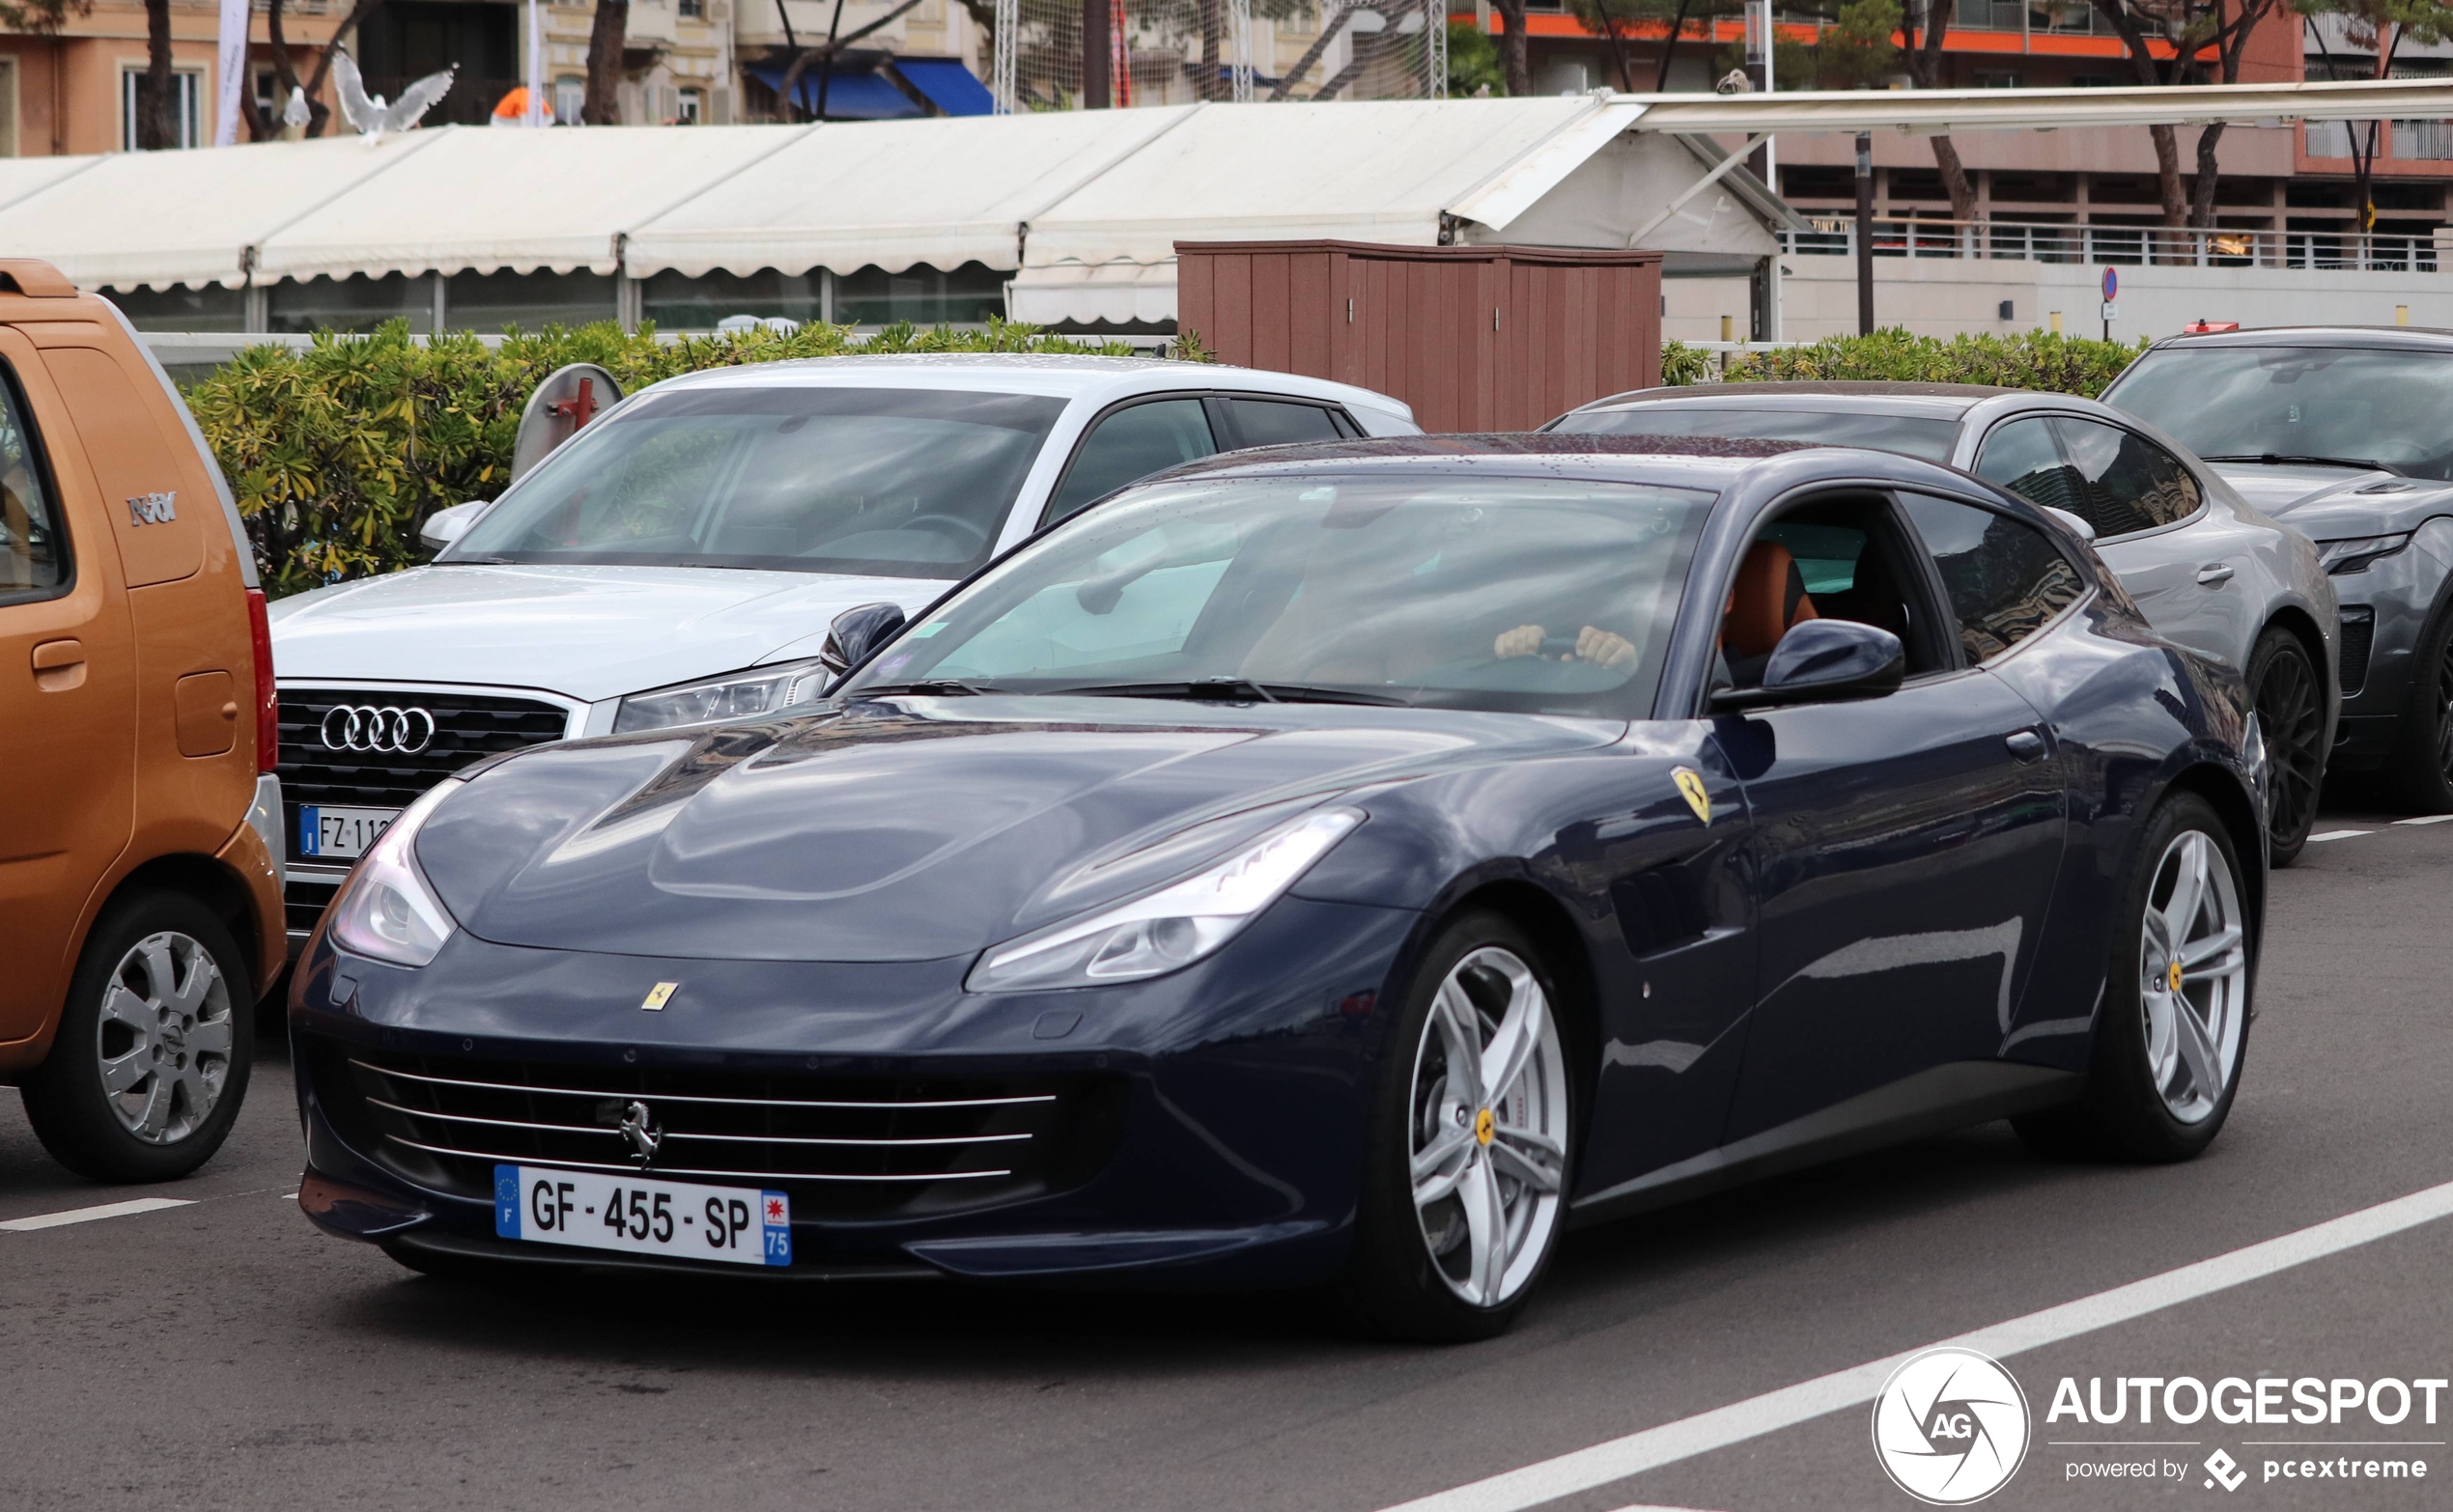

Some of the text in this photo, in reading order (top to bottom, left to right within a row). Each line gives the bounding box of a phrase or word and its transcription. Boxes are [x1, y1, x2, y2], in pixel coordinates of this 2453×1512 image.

[354, 819, 389, 849] 11
[504, 1208, 512, 1223] F
[766, 1231, 788, 1256] 75
